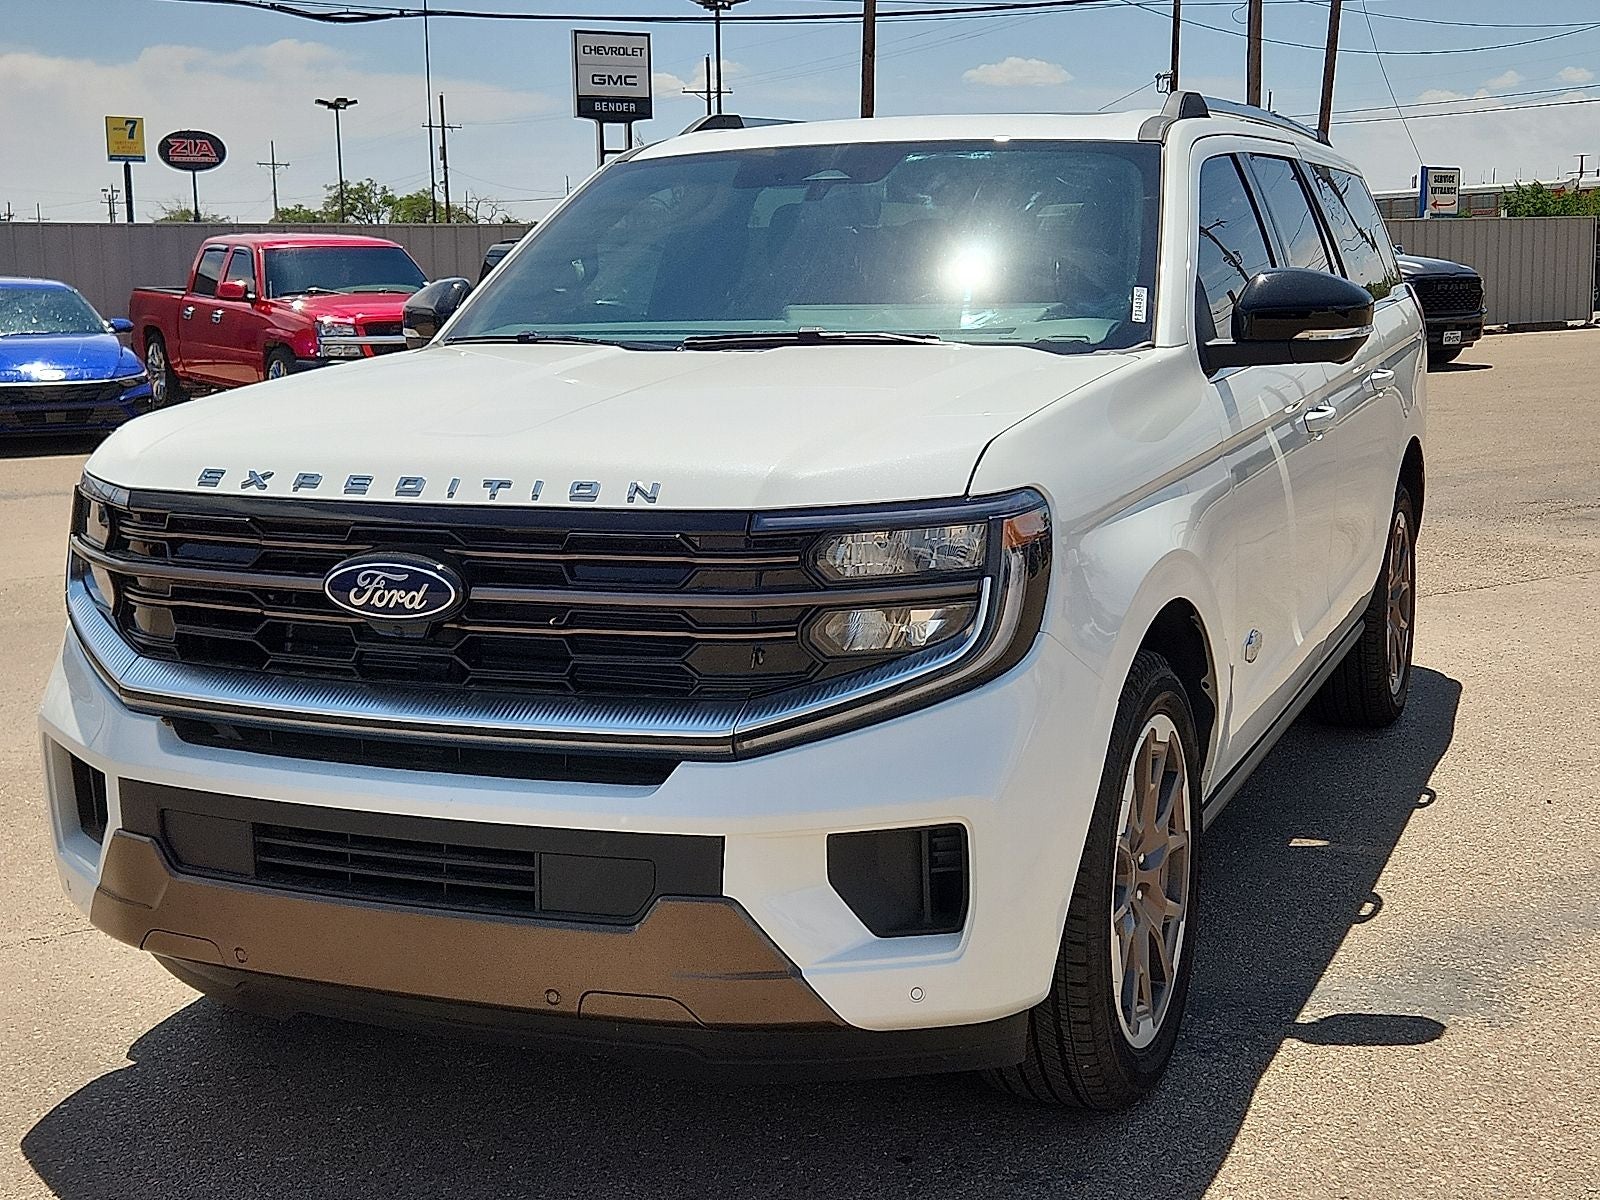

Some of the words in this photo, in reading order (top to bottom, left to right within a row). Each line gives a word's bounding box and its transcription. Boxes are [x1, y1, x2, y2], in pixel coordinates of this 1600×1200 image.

[582, 45, 644, 57] CHEVROLET
[591, 73, 637, 87] GMC
[594, 101, 636, 112] BENDER
[124, 120, 138, 140] 7
[167, 139, 216, 156] ZIA
[197, 468, 661, 503] EXPEDITION
[349, 569, 429, 610] Ford
